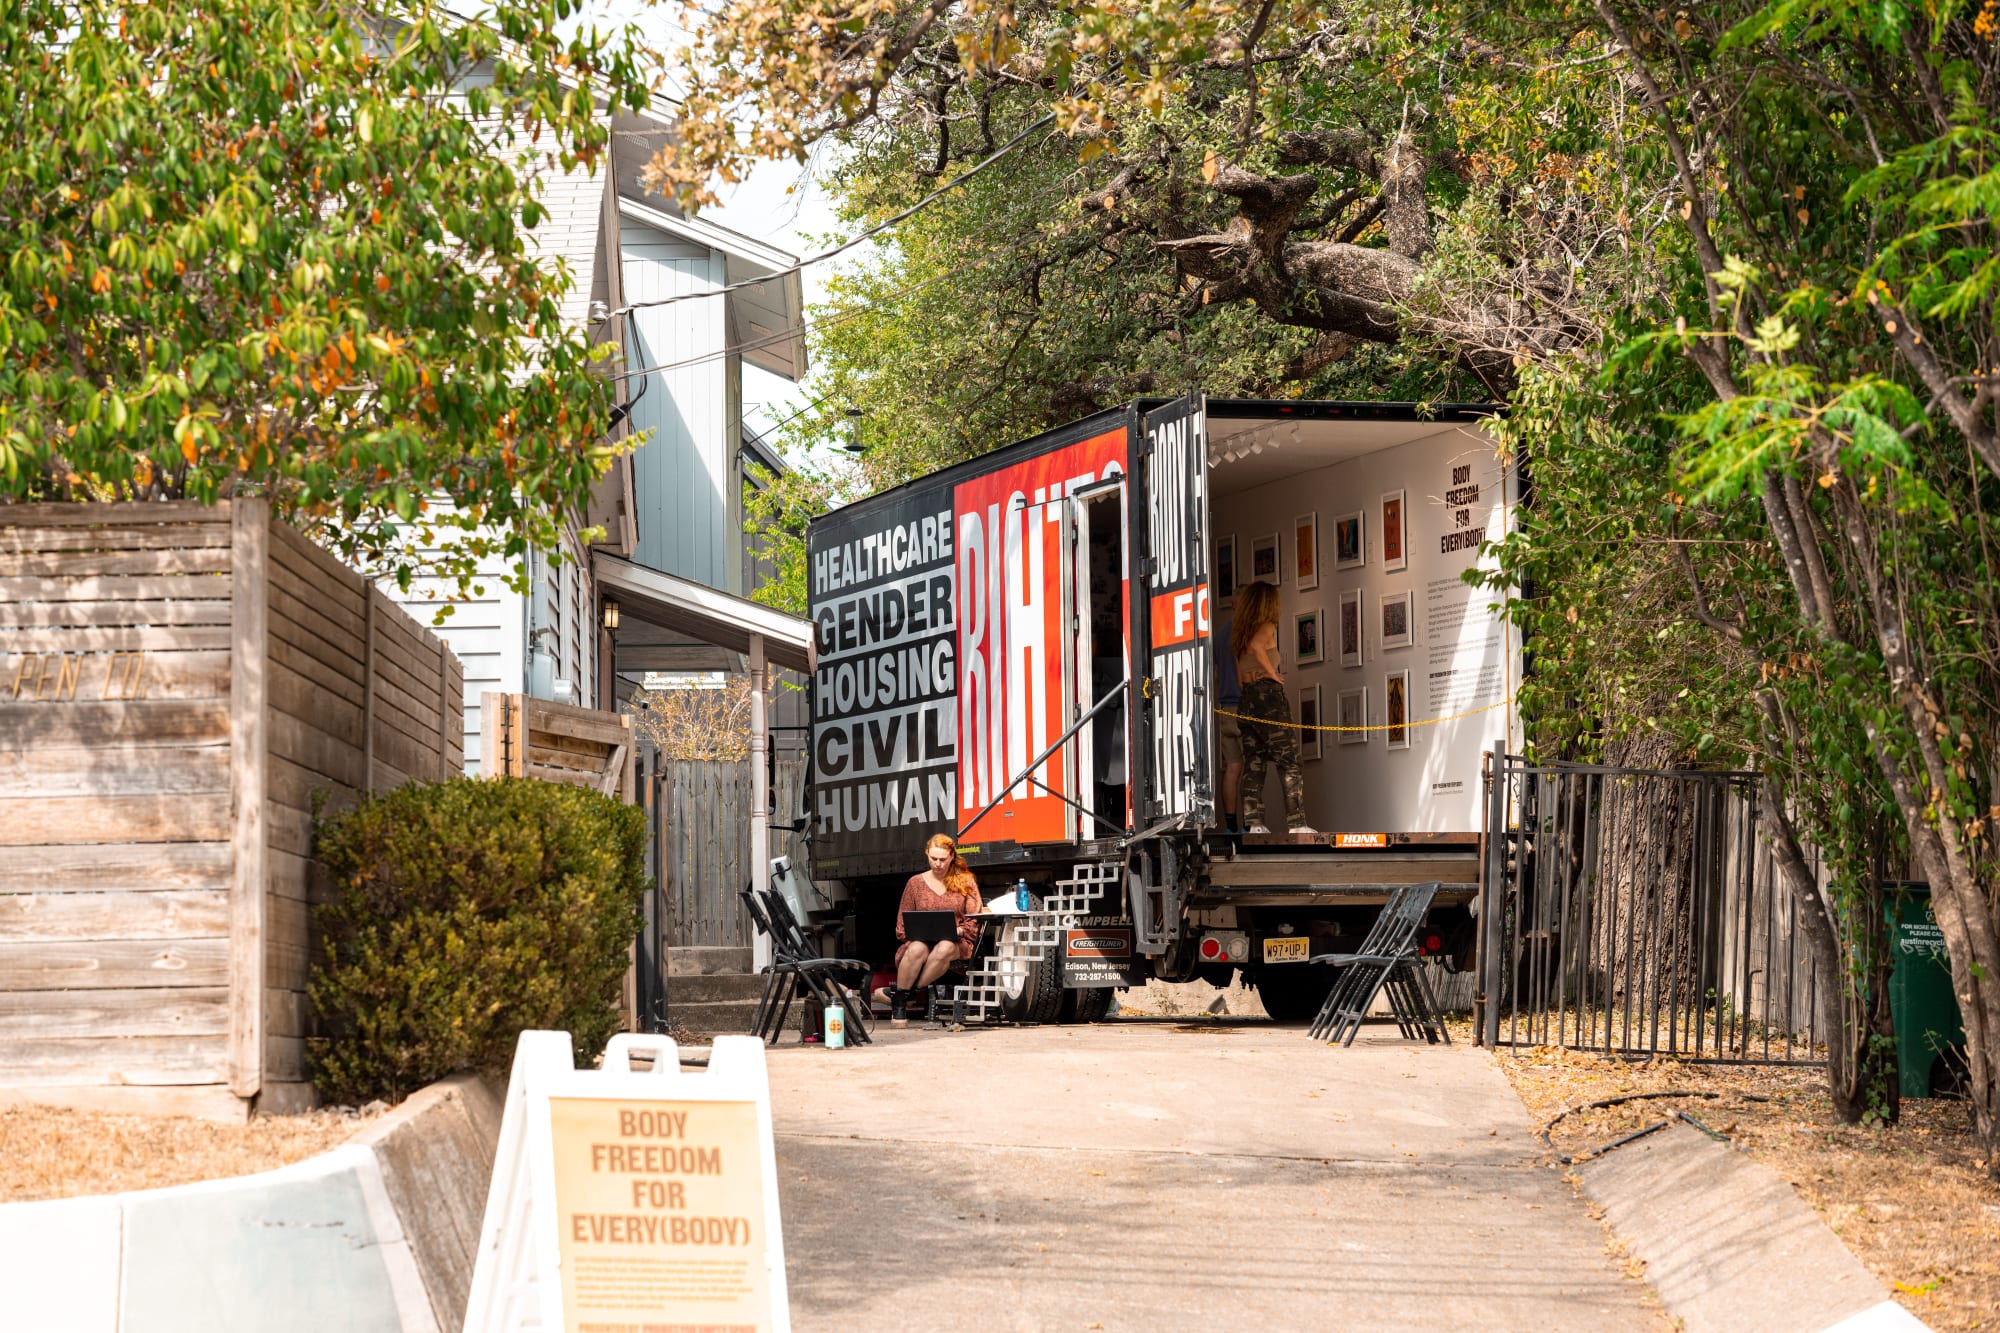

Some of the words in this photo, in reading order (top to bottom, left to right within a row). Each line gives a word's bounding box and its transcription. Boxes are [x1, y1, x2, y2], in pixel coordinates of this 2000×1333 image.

[1453, 464, 1470, 486] BODY
[1149, 417, 1187, 588] BODY
[1446, 484, 1479, 509] FREEDOM
[1456, 509, 1469, 528] FOR
[815, 510, 953, 595] HEALTHCARE
[818, 575, 953, 656] GENDER
[13, 653, 83, 701] PEN
[816, 639, 954, 717] HOUSING
[816, 708, 955, 777] CIVIL
[816, 771, 956, 835] HUMAN
[1343, 834, 1378, 844] HONK
[1062, 915, 1133, 927] CAMPBELL
[1075, 940, 1122, 948] FREIGHTLINER
[1065, 962, 1091, 971] Edison,
[1092, 962, 1107, 970] New
[1108, 962, 1131, 972] Jersey
[1074, 972, 1121, 981] 732-287-1500
[619, 1109, 688, 1139] BODY
[592, 1143, 722, 1176] FREEDOM
[632, 1180, 687, 1209] FOR
[572, 1213, 751, 1246] EVERY(BODY)
